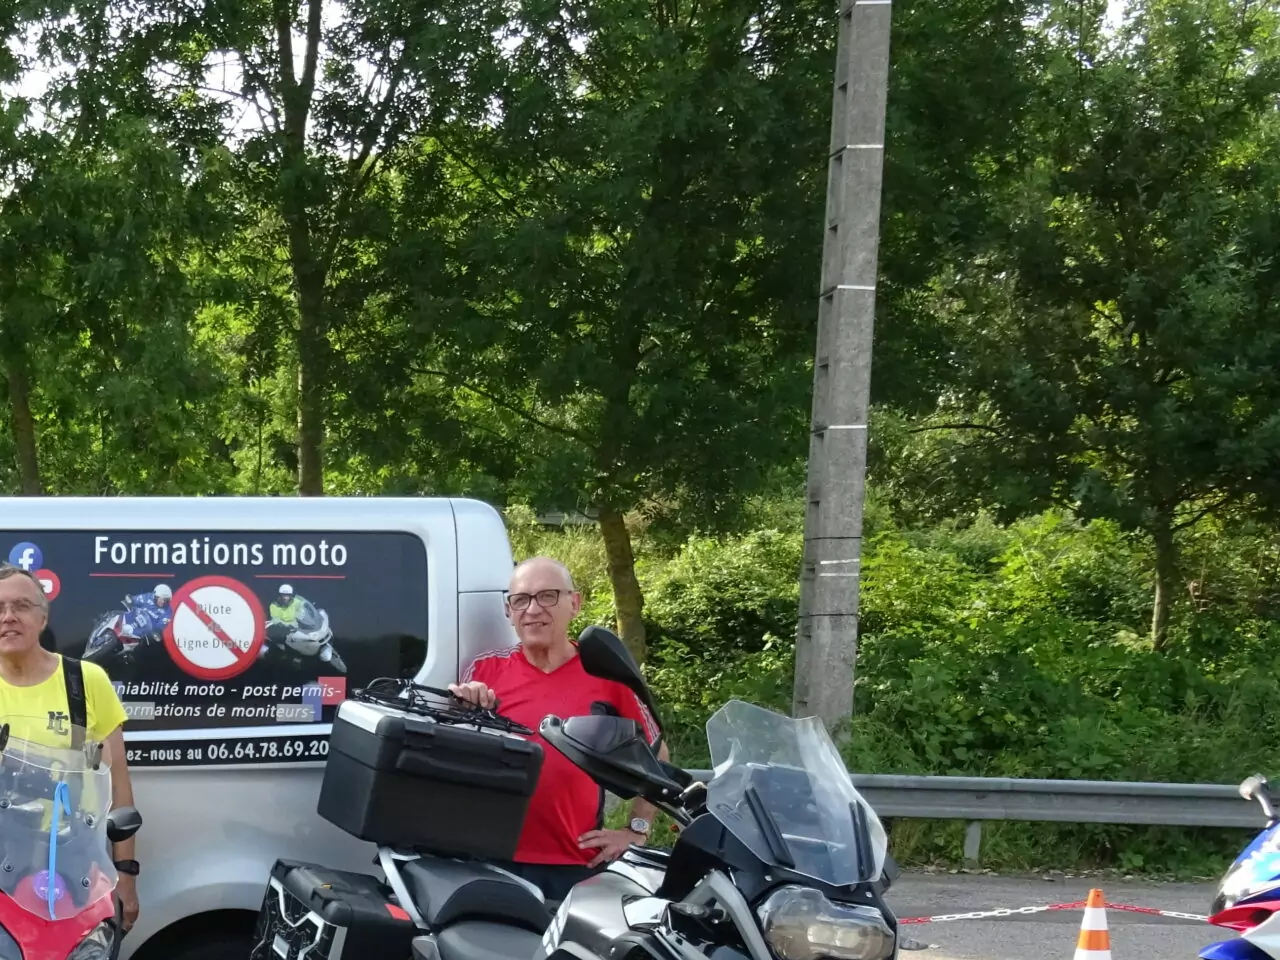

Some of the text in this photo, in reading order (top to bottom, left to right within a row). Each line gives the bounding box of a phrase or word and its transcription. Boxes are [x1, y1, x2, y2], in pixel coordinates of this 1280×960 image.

[94, 536, 348, 566] Formations moto
[196, 603, 232, 615] Pilote
[177, 638, 209, 650] Ligne
[184, 683, 225, 696] moto
[242, 684, 277, 699] post
[206, 703, 226, 717] de
[187, 748, 202, 760] au
[207, 740, 330, 760] 06.64.78.69.20
